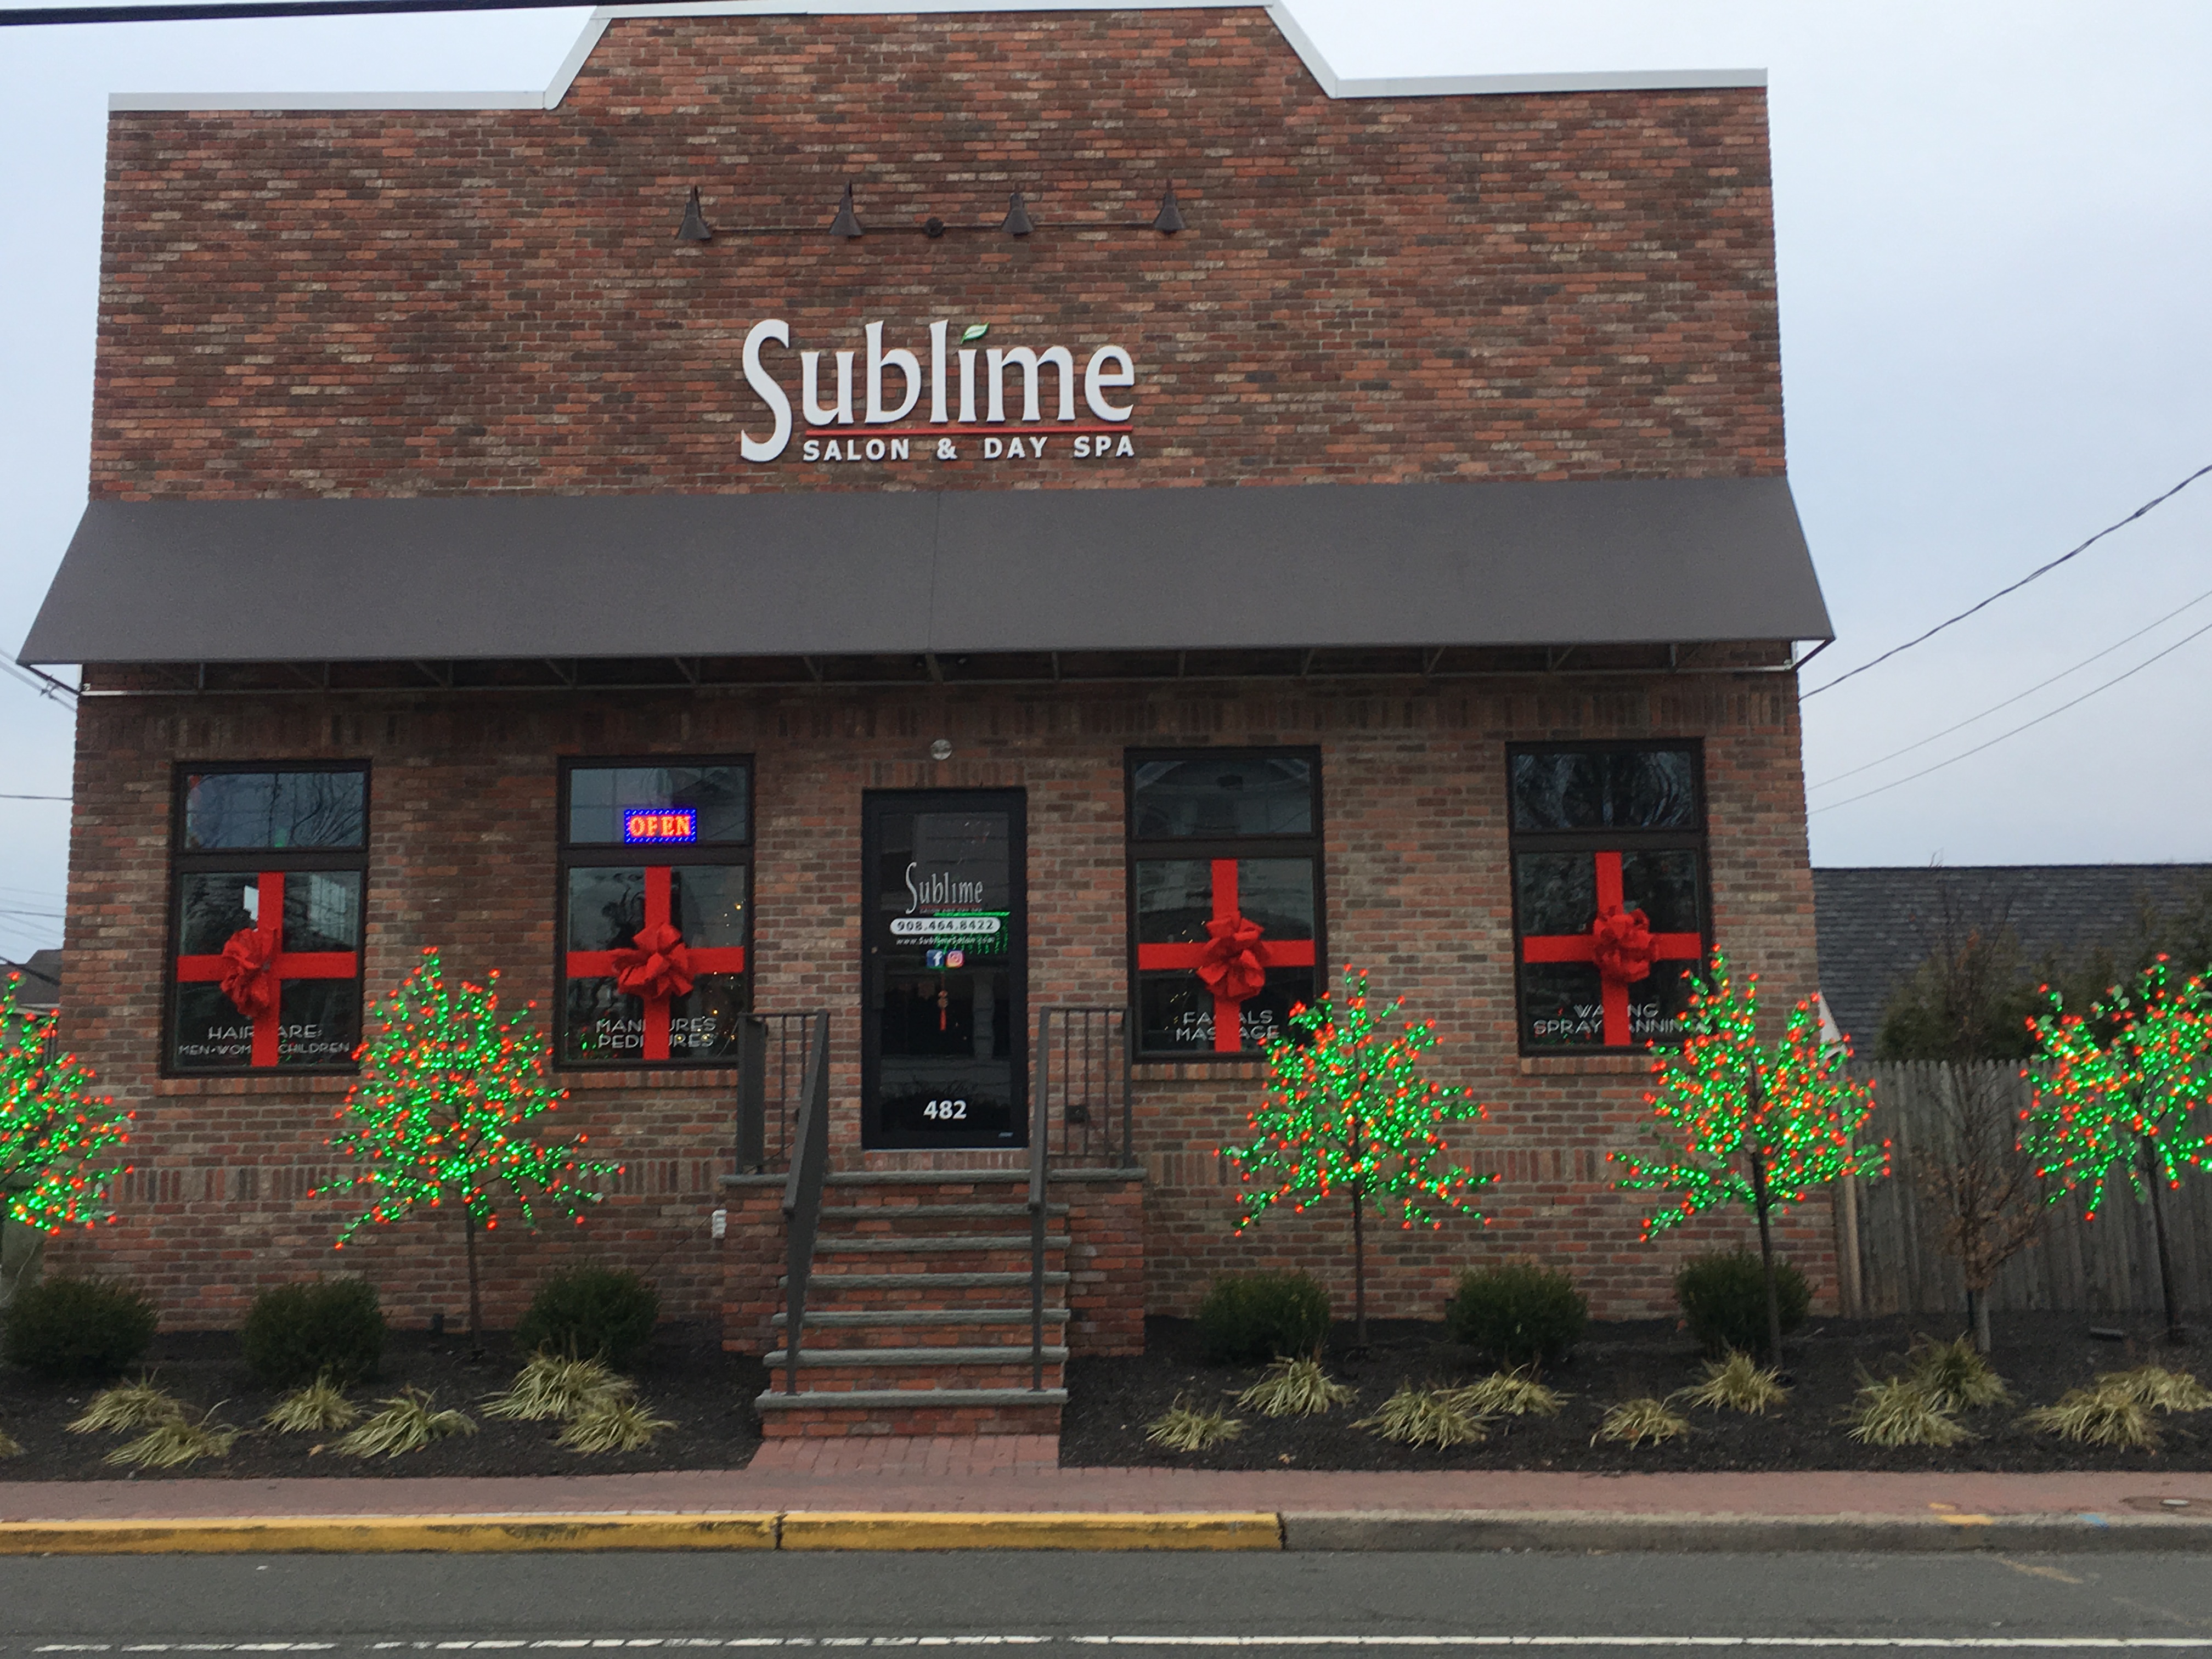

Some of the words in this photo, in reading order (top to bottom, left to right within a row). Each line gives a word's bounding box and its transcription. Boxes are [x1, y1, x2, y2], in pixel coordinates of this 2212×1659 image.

[740, 318, 1135, 462] Sublime
[803, 438, 910, 462] SALON
[936, 437, 957, 460] &
[984, 436, 1048, 459] DAY
[1074, 435, 1135, 458] SPA
[630, 815, 691, 837] OPEN
[905, 862, 983, 915] Sublime
[1182, 1009, 1273, 1026] FAALS
[1573, 1003, 1659, 1018] WANG
[278, 1024, 323, 1039] ARE:
[596, 1018, 717, 1033] MANIURES
[1176, 1024, 1280, 1041] MASAGE
[1533, 1019, 1602, 1035] SPRAY
[598, 1033, 715, 1048] PEDIURES
[923, 1099, 967, 1120] 482
